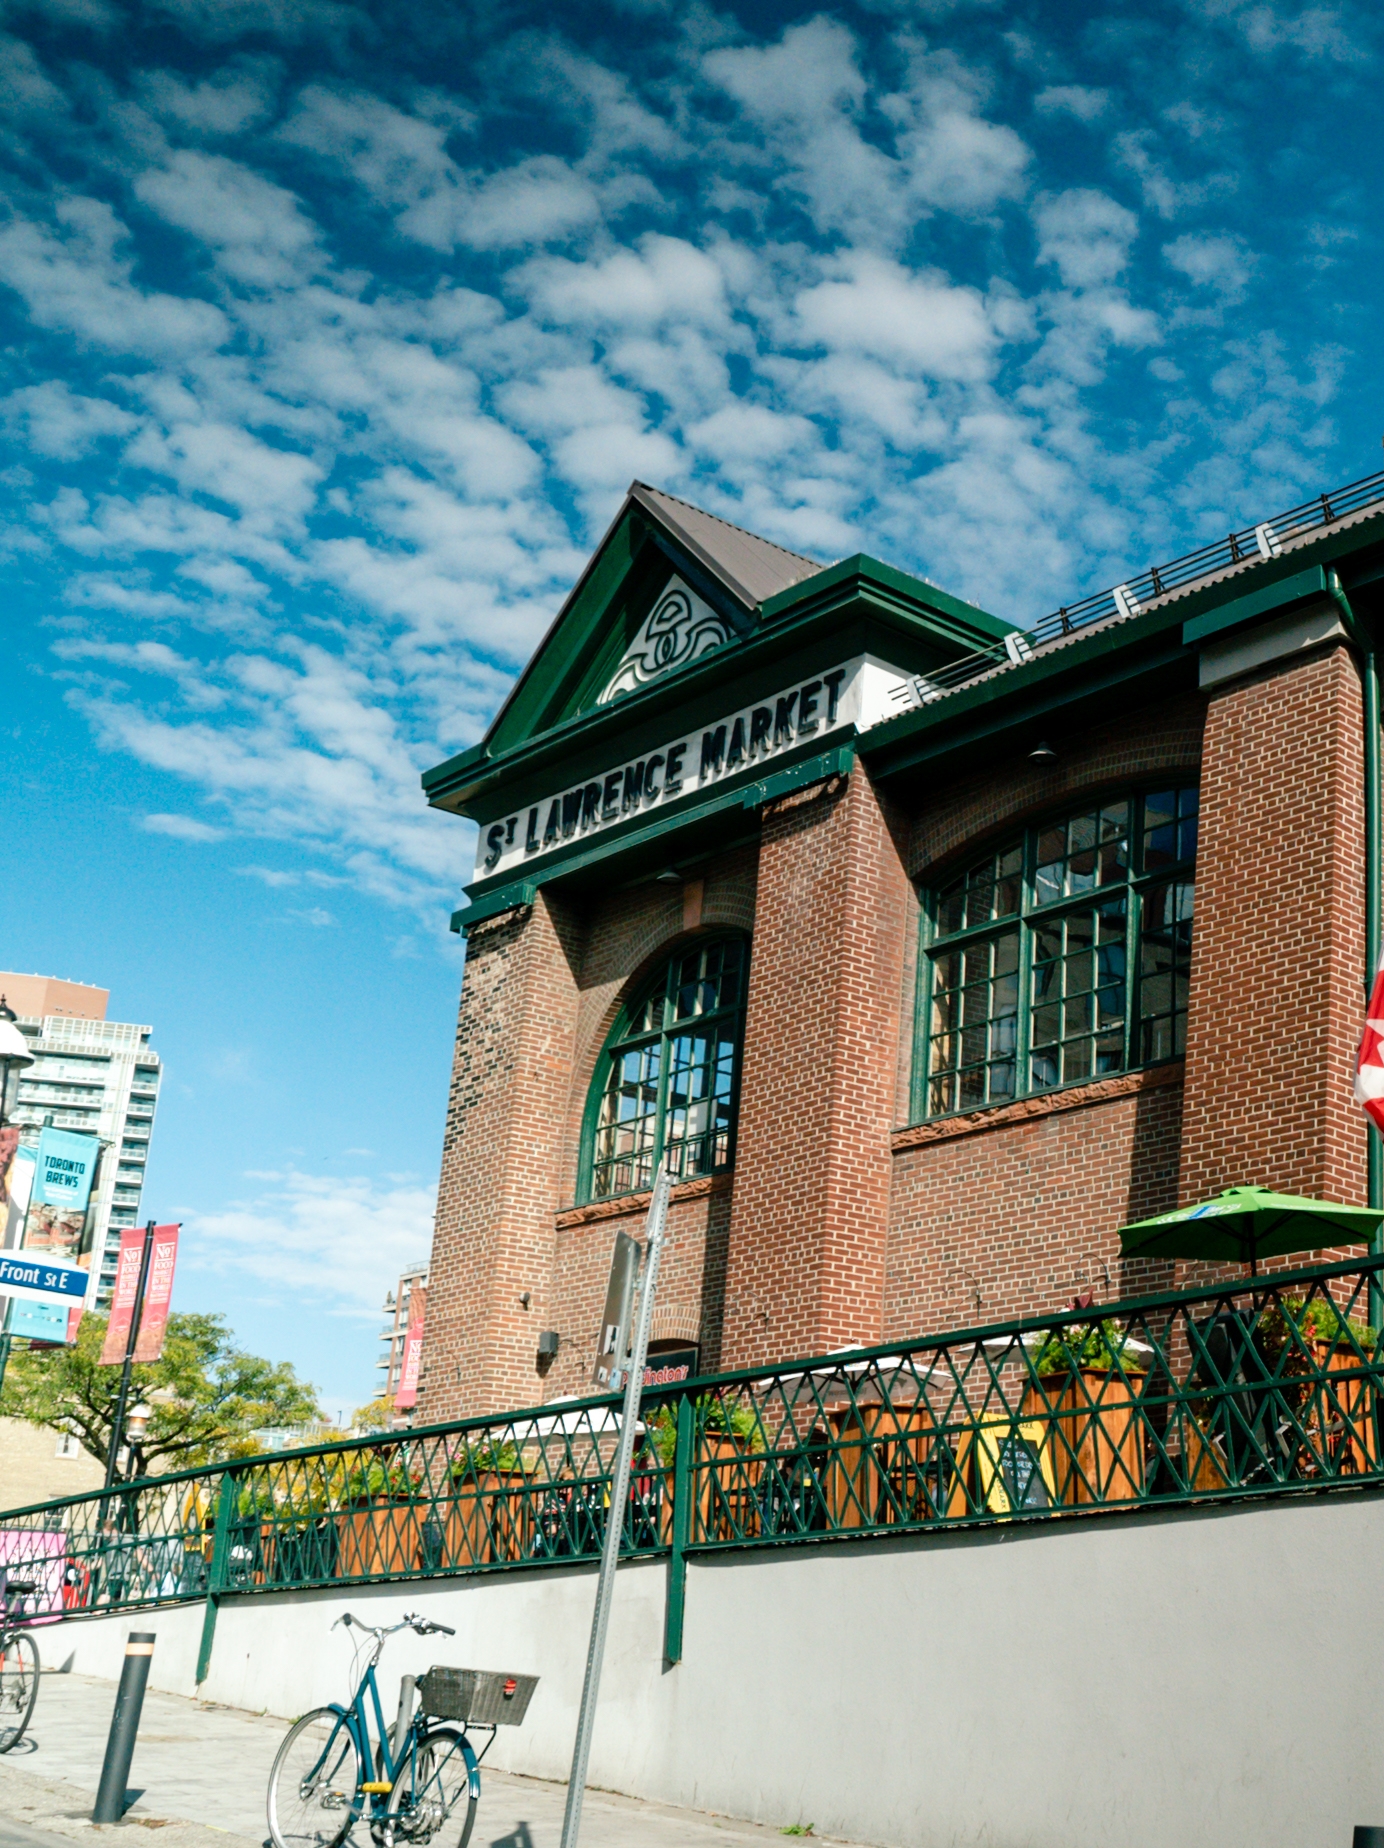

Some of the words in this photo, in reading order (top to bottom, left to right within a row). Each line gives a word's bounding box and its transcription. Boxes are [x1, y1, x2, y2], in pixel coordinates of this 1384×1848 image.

[525, 742, 688, 852] LAWRENCE
[699, 668, 847, 780] MARKET
[44, 1155, 86, 1175] TORONTO
[45, 1171, 79, 1188] BREWS
[0, 1261, 40, 1284] Front
[44, 1272, 57, 1287] St
[58, 1272, 70, 1289] E
[622, 1365, 688, 1390] Pdington's
